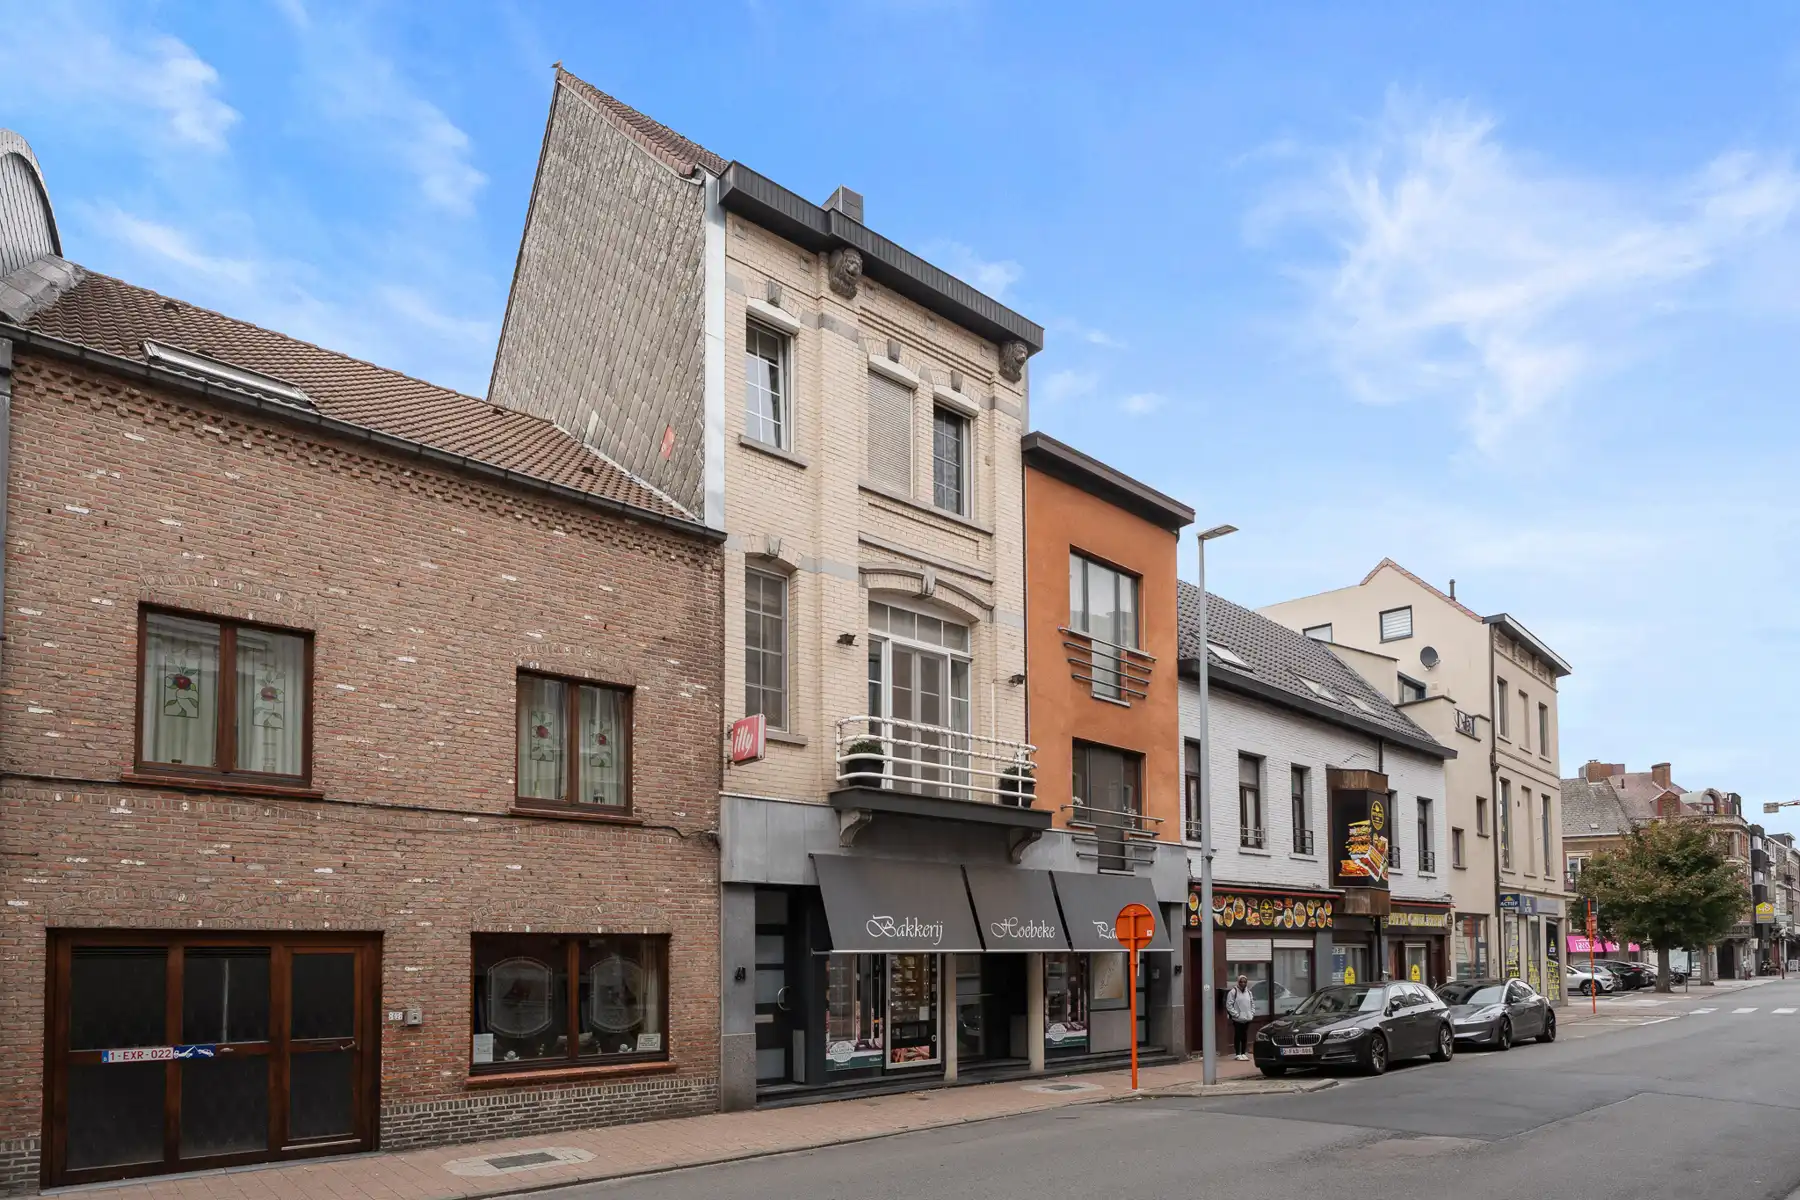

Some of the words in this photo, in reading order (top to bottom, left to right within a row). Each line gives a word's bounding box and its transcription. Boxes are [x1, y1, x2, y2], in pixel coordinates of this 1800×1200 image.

[734, 725, 754, 757] illy
[866, 914, 944, 946] Bakkerij
[990, 917, 1056, 939] Hoebeke
[1092, 919, 1118, 939] Pa
[109, 1049, 172, 1061] 1-EXR-022
